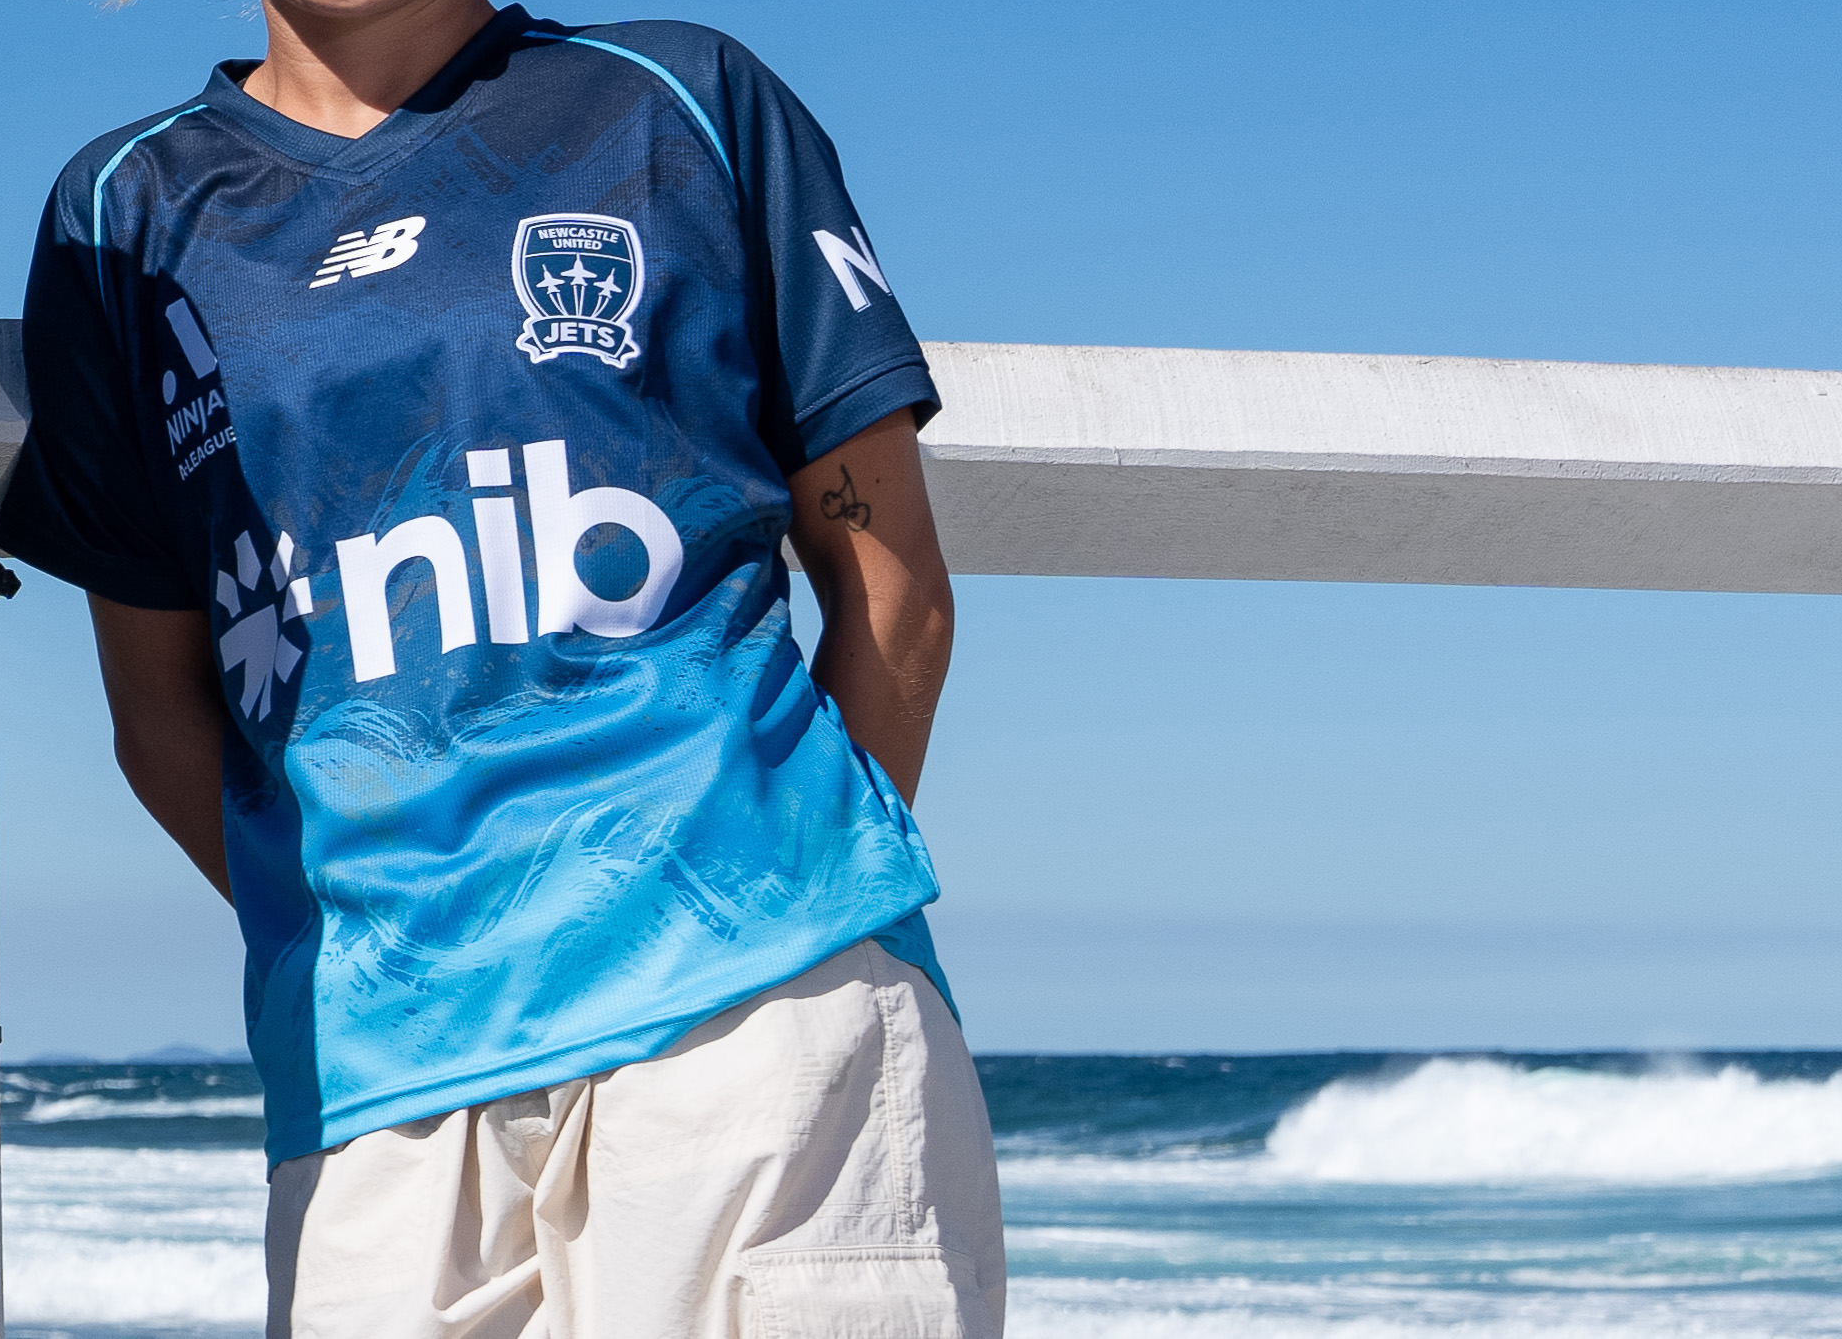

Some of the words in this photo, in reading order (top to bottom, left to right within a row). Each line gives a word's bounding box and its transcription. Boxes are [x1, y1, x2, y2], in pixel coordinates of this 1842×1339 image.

[538, 227, 620, 244] NEWCASTLE
[552, 238, 603, 251] UNITED
[542, 321, 615, 349] JETS
[166, 388, 225, 456] NINJA
[178, 425, 237, 481] A-LEAGUE
[335, 439, 684, 684] nib
